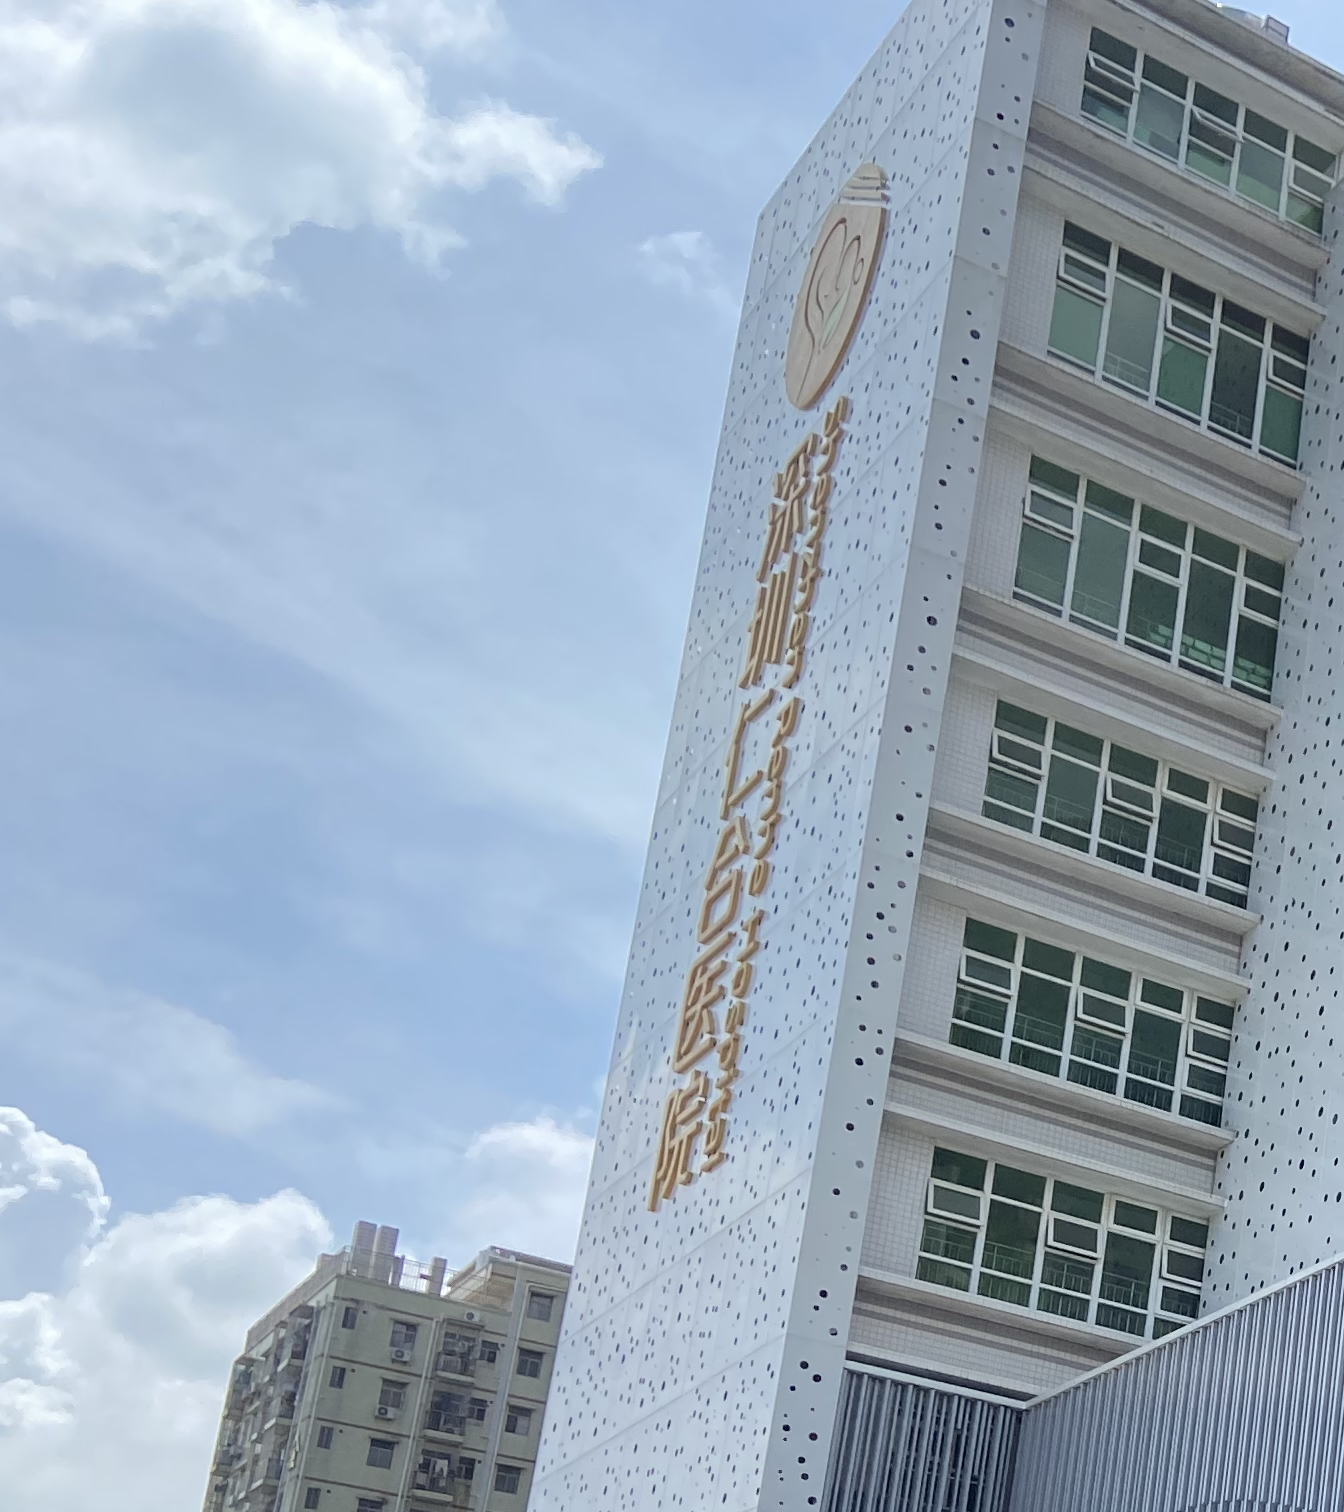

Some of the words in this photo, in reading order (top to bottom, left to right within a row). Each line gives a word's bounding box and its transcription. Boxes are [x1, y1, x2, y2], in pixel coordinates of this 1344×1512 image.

[647, 432, 819, 1212] 深圳仁合医院
